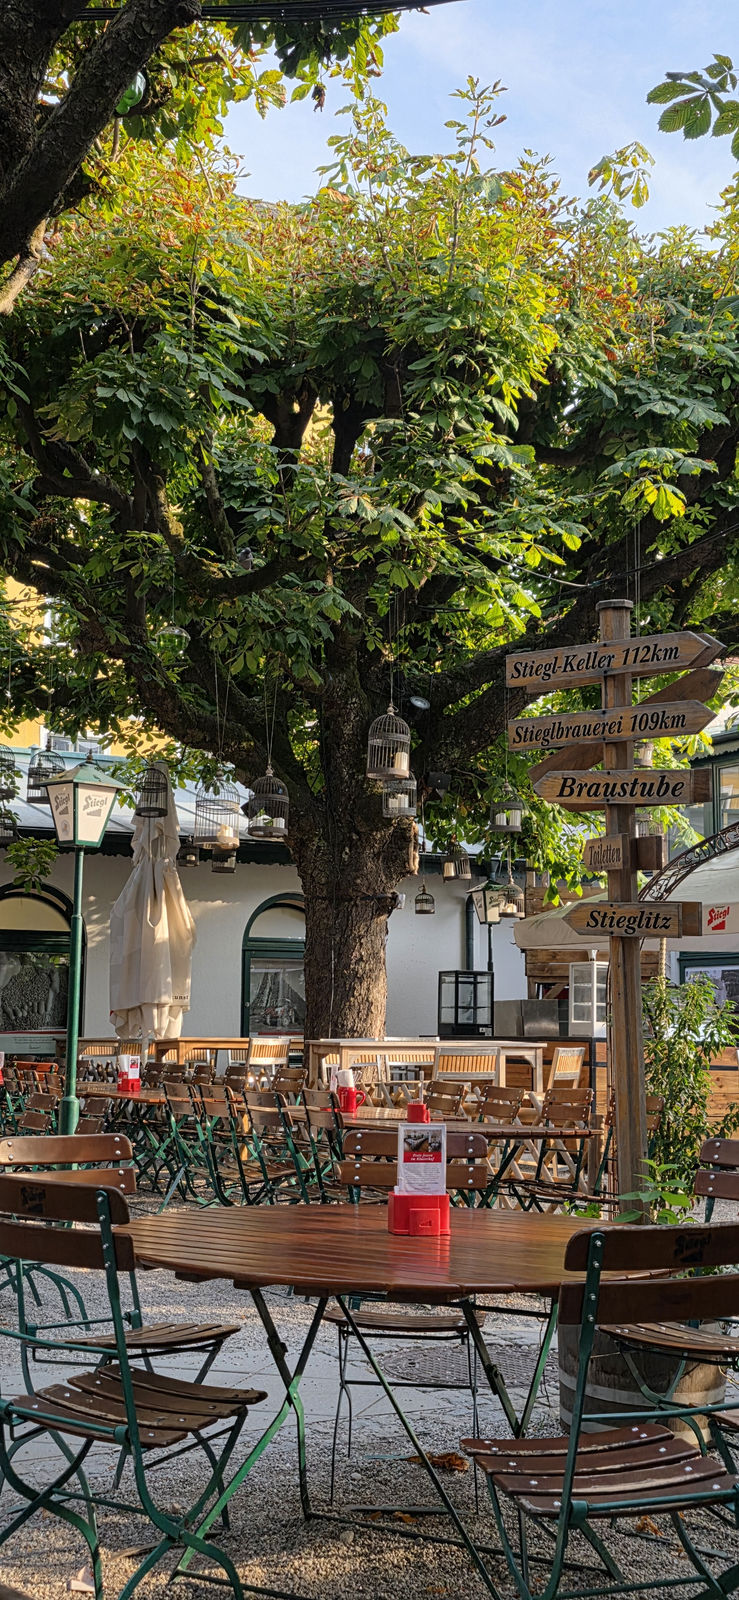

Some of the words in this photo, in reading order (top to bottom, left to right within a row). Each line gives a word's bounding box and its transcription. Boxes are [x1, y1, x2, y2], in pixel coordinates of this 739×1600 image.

[510, 652, 615, 682] Stiegl-Keller
[621, 643, 680, 666] 112km
[512, 715, 623, 747] Stieglbrauerei
[629, 710, 686, 733] 109km
[556, 775, 685, 798] Braustube
[82, 794, 108, 812] Stiegl
[588, 842, 621, 866] Toiletten
[586, 908, 672, 935] Stieglitz
[707, 906, 730, 927] Stiegl
